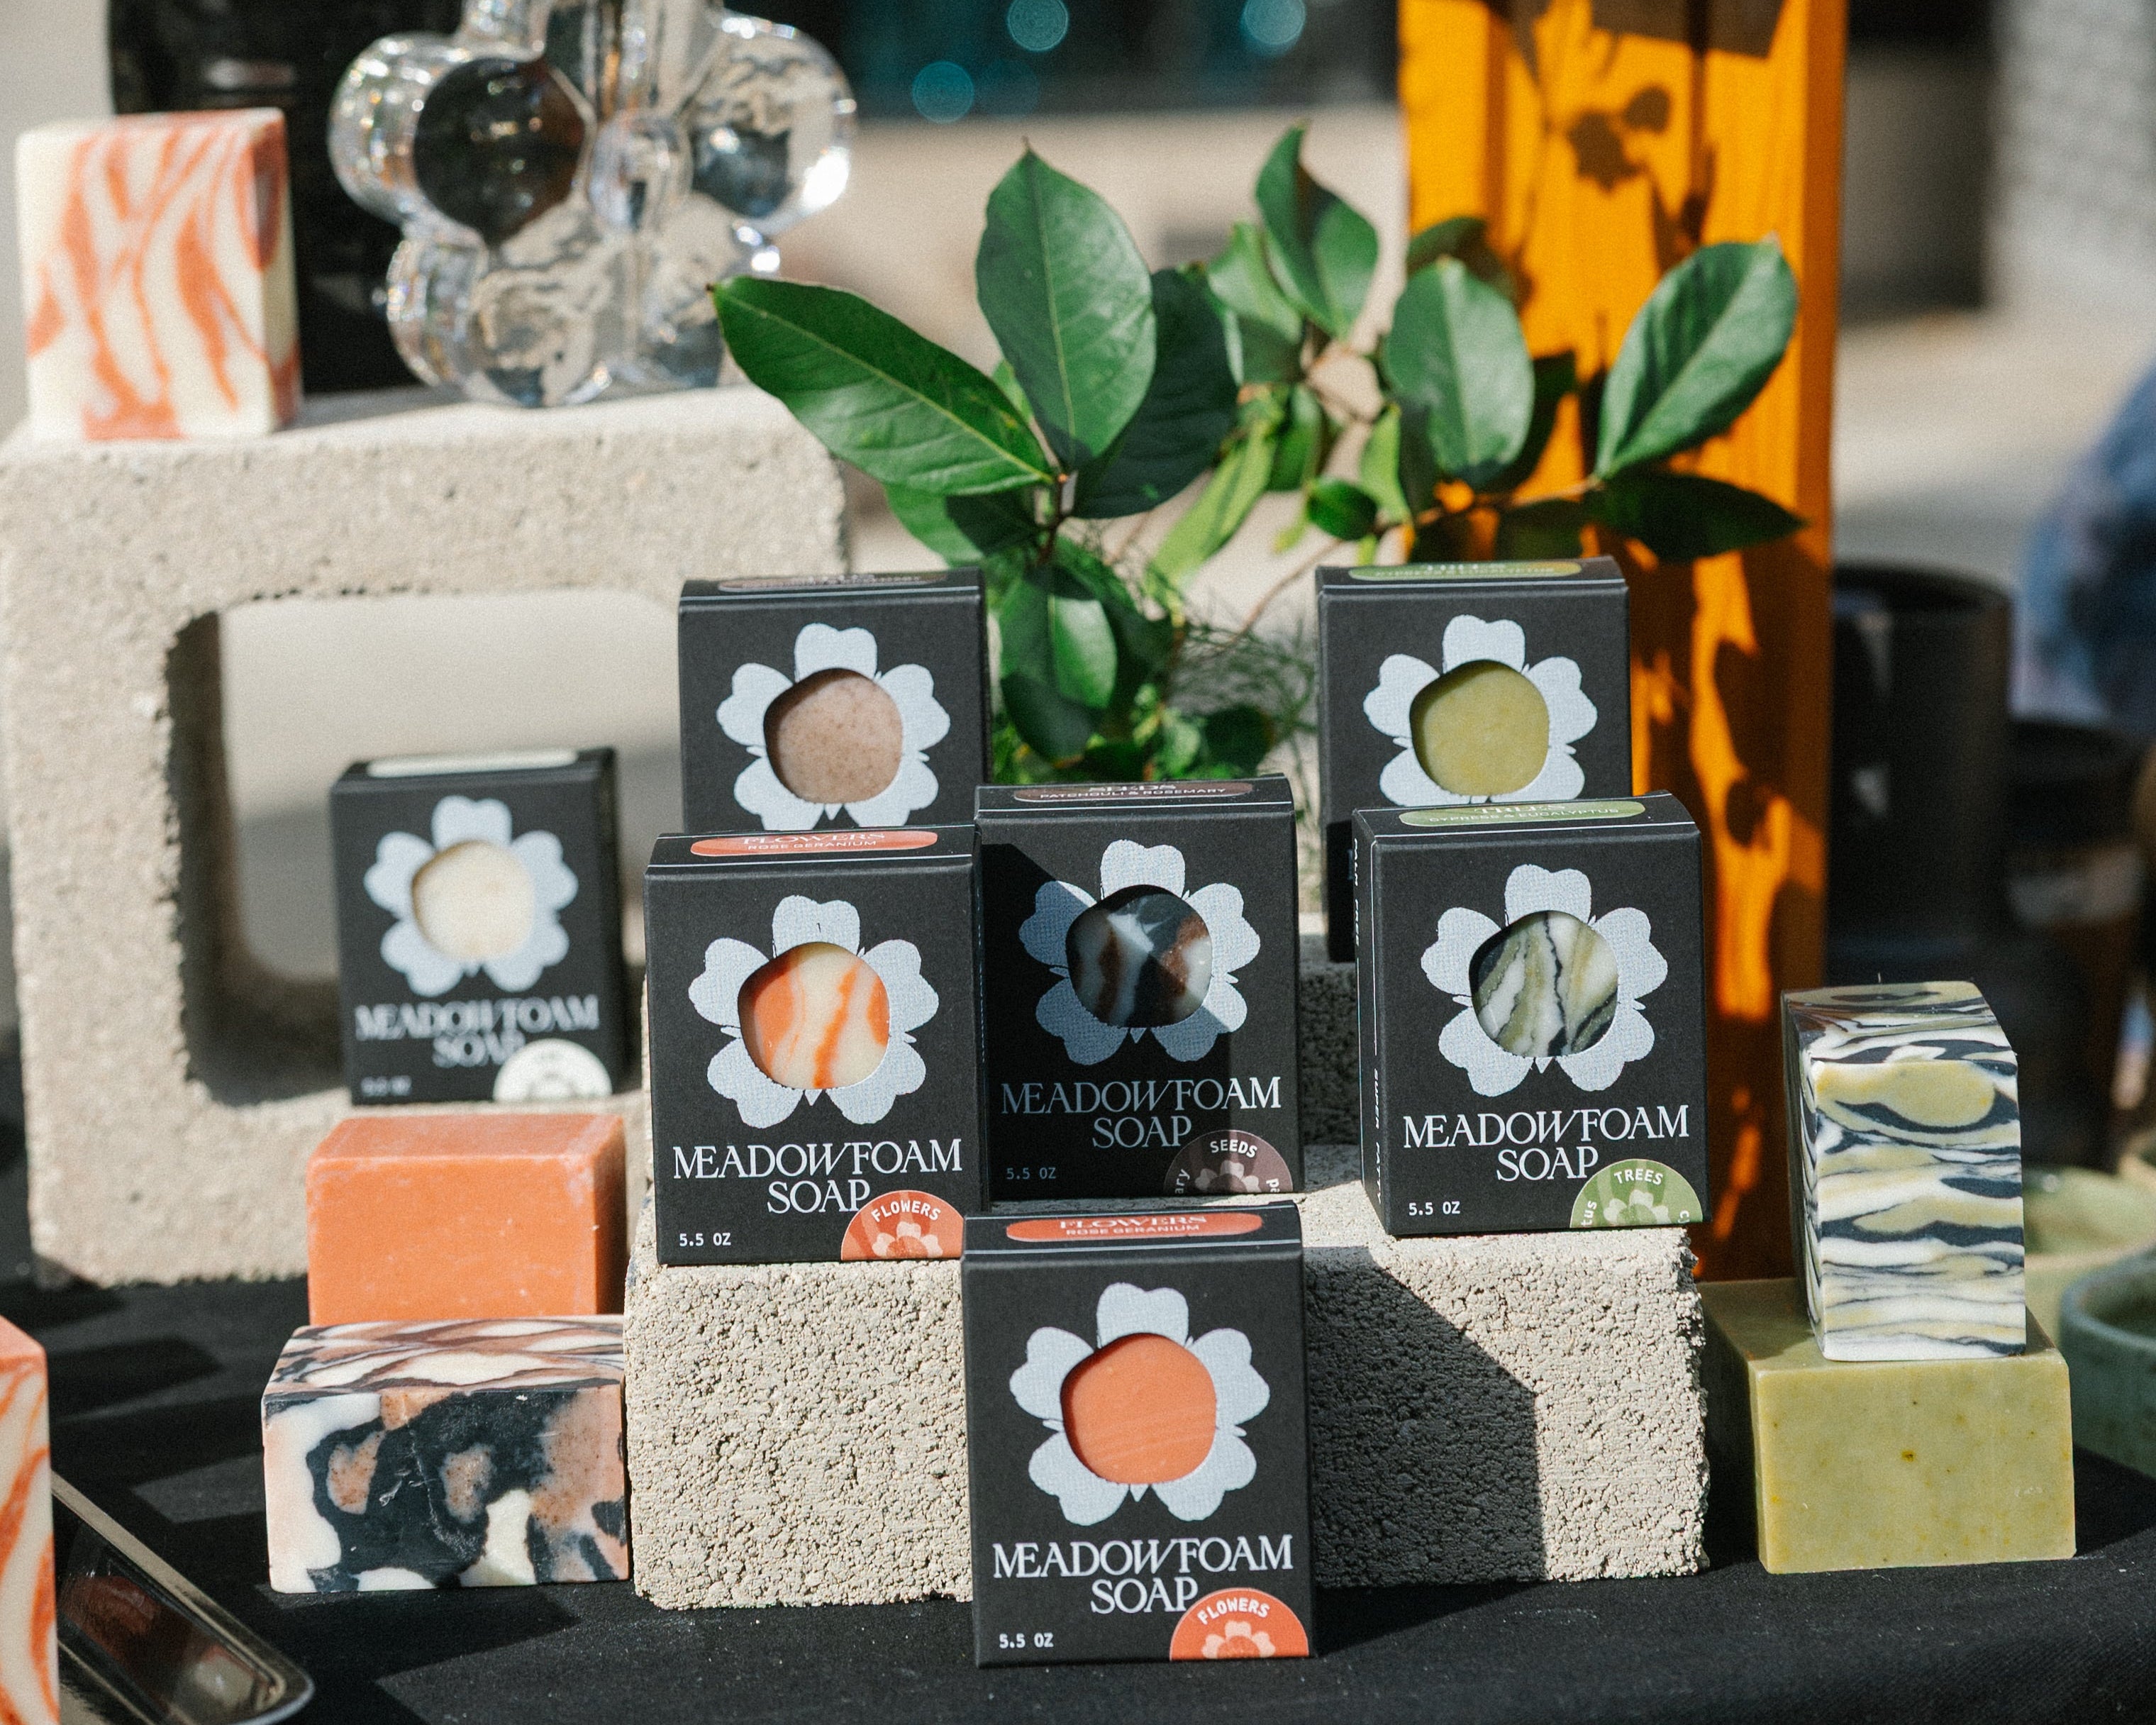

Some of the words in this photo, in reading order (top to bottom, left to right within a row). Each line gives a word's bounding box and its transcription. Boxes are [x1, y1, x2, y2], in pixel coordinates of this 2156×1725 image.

[1429, 814, 1500, 823] CYPRESS
[1518, 808, 1619, 818] EUCALYPTUS
[743, 832, 885, 845] FLOWERS
[794, 841, 877, 850] GERANIUM
[1001, 1076, 1282, 1114] MEADOWFOAM
[1092, 1115, 1192, 1149] SOAP
[1403, 1104, 1689, 1148] MEADOWFOAM
[1210, 1138, 1258, 1158] SEEDS
[672, 1138, 962, 1180] MEADOWFOAM
[1496, 1146, 1599, 1182] SOAP
[1006, 1167, 1030, 1180] 5.5
[1039, 1167, 1057, 1180] OZ
[1613, 1167, 1664, 1186] TREES
[766, 1178, 871, 1214] SOAP
[871, 1199, 942, 1223] FLOWERS
[1408, 1202, 1434, 1216] 5.5
[1442, 1201, 1461, 1215] OZ
[1060, 1215, 1207, 1229] FLOWERS
[1066, 1227, 1108, 1236] ROSE
[1113, 1224, 1200, 1235] GERANIUM
[679, 1233, 704, 1247] 5.5
[713, 1232, 732, 1246] OZ
[992, 1533, 1294, 1579] MEADOWFOAM
[1090, 1576, 1199, 1614] SOAP
[1197, 1596, 1271, 1625] FLOWERS
[999, 1633, 1026, 1649] 5.5
[1033, 1632, 1055, 1648] OZ
